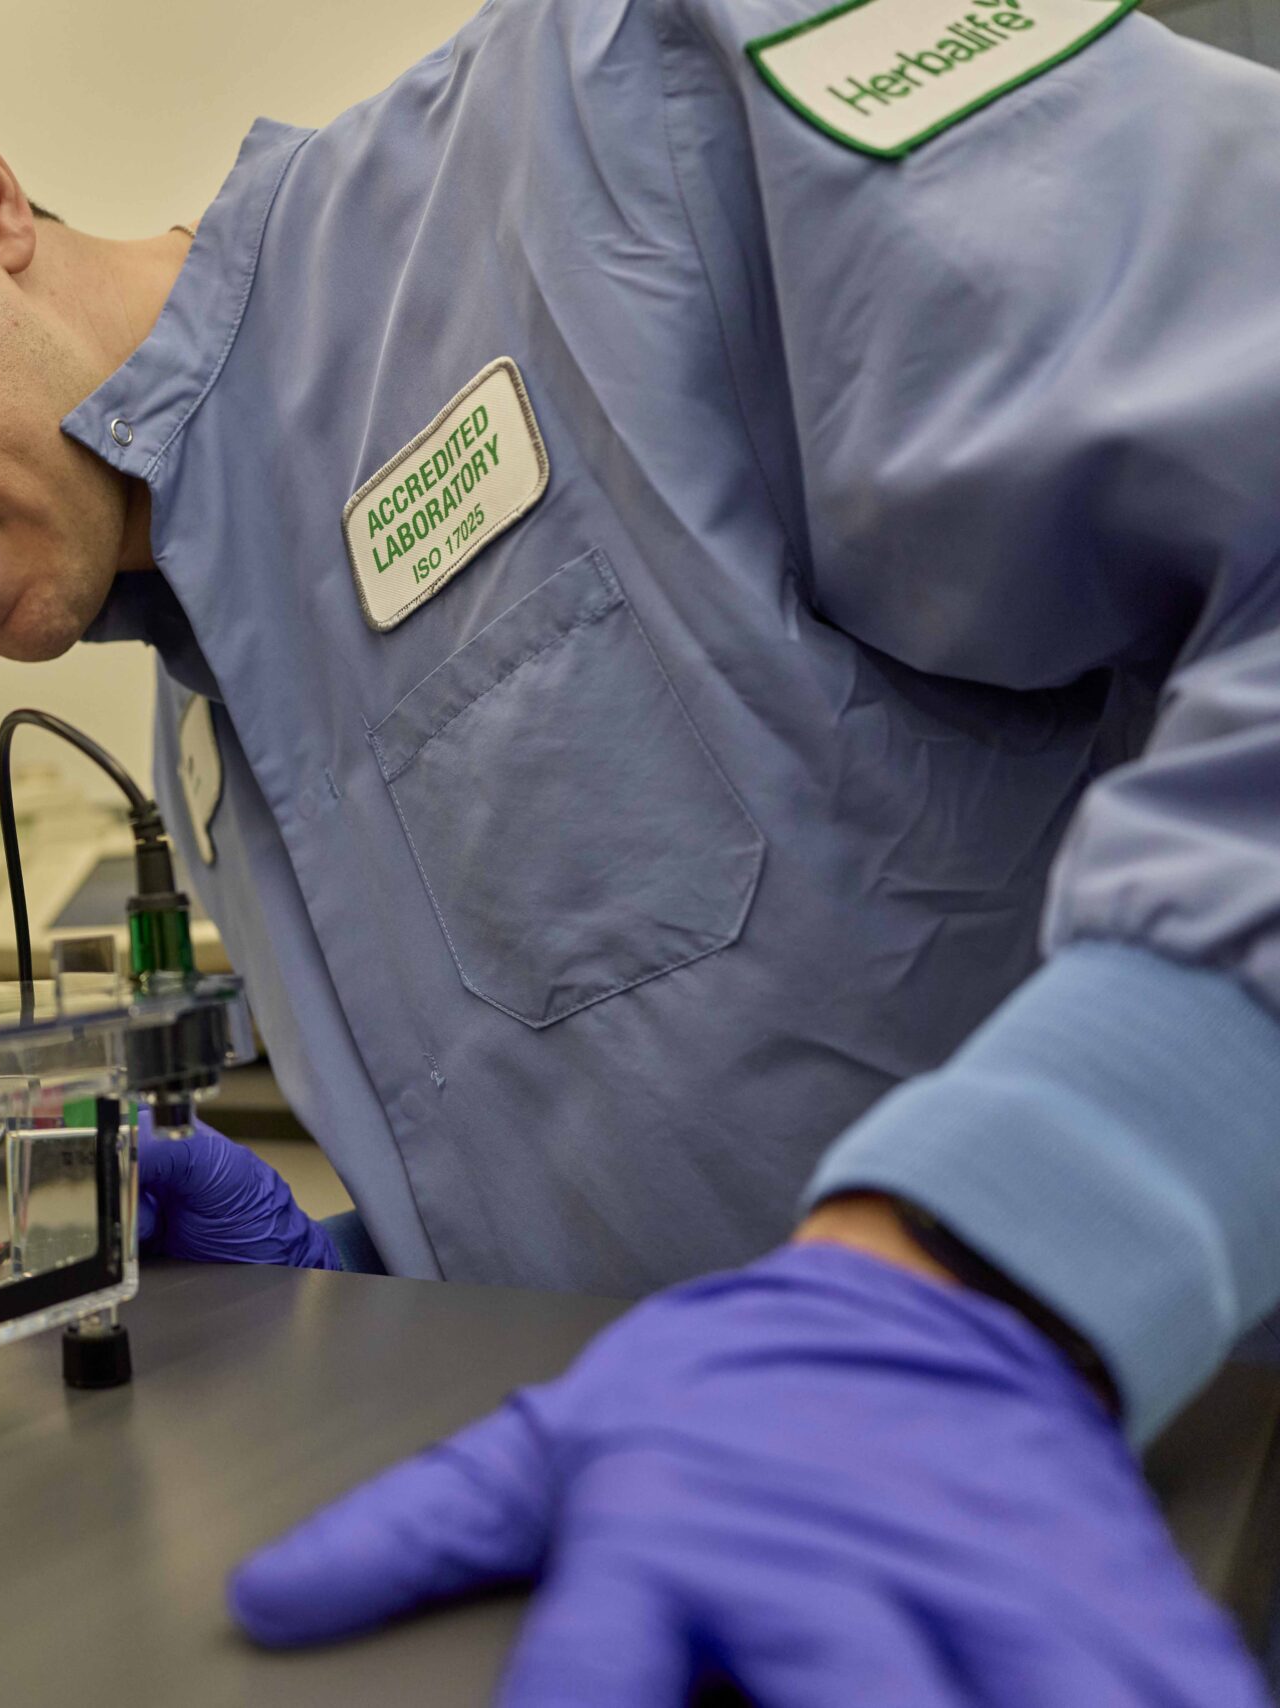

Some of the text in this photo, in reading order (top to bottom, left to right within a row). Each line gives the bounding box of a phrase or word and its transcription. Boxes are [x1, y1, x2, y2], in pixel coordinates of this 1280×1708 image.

[827, 12, 1034, 115] Herbalife
[367, 405, 489, 539] ACCREDITED
[372, 433, 500, 574] LABORATORY
[412, 503, 485, 584] ISO 17025
